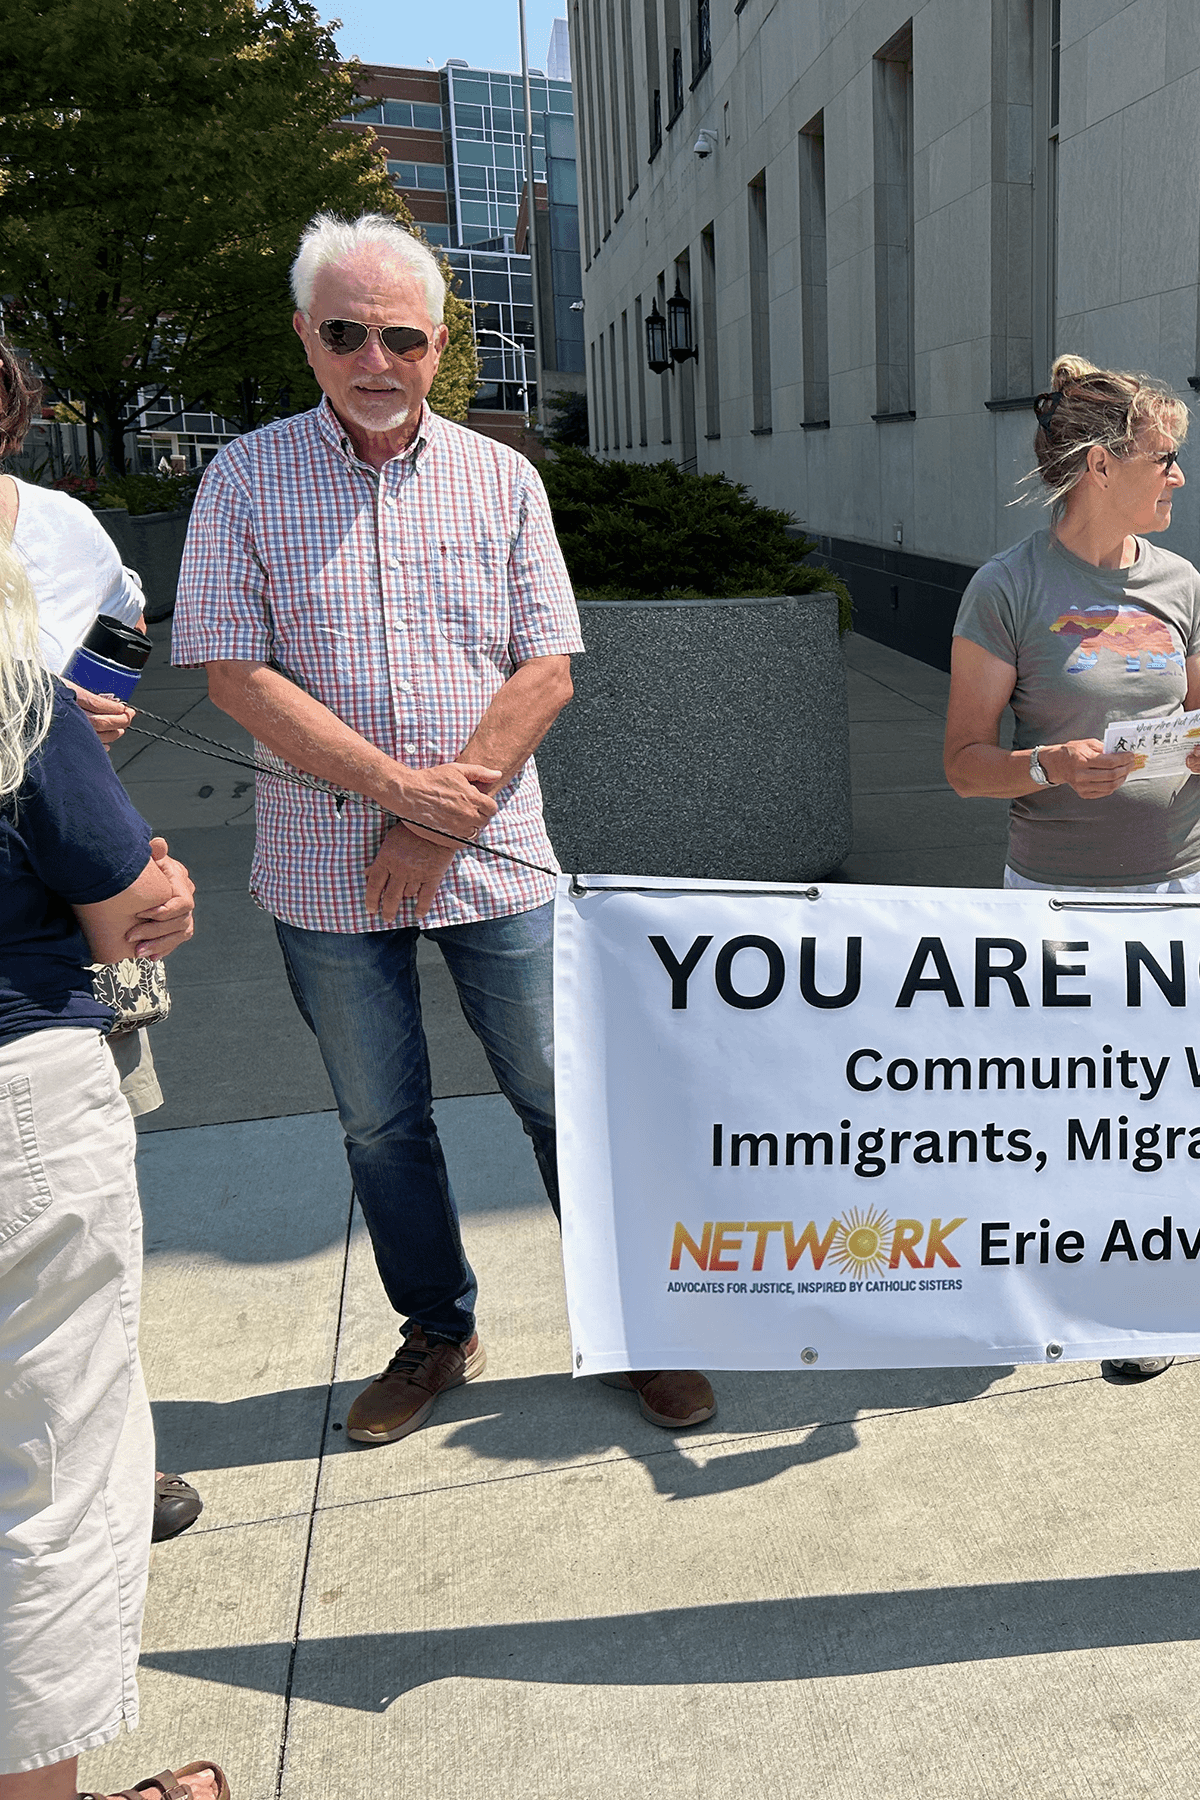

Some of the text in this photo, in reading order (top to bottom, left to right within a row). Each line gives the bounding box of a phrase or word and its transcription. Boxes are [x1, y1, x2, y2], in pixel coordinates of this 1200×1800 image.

[648, 935, 861, 1009] YOU
[895, 937, 1091, 1007] ARE
[847, 1045, 1170, 1100] Community
[713, 1120, 1046, 1177] Immigrants,
[668, 1216, 968, 1272] NETWORK
[981, 1219, 1084, 1265] Erie
[667, 1279, 963, 1295] ADVOCATES FOR JUSTICE, INSPIRED BY CATHOLIC SISTERS
